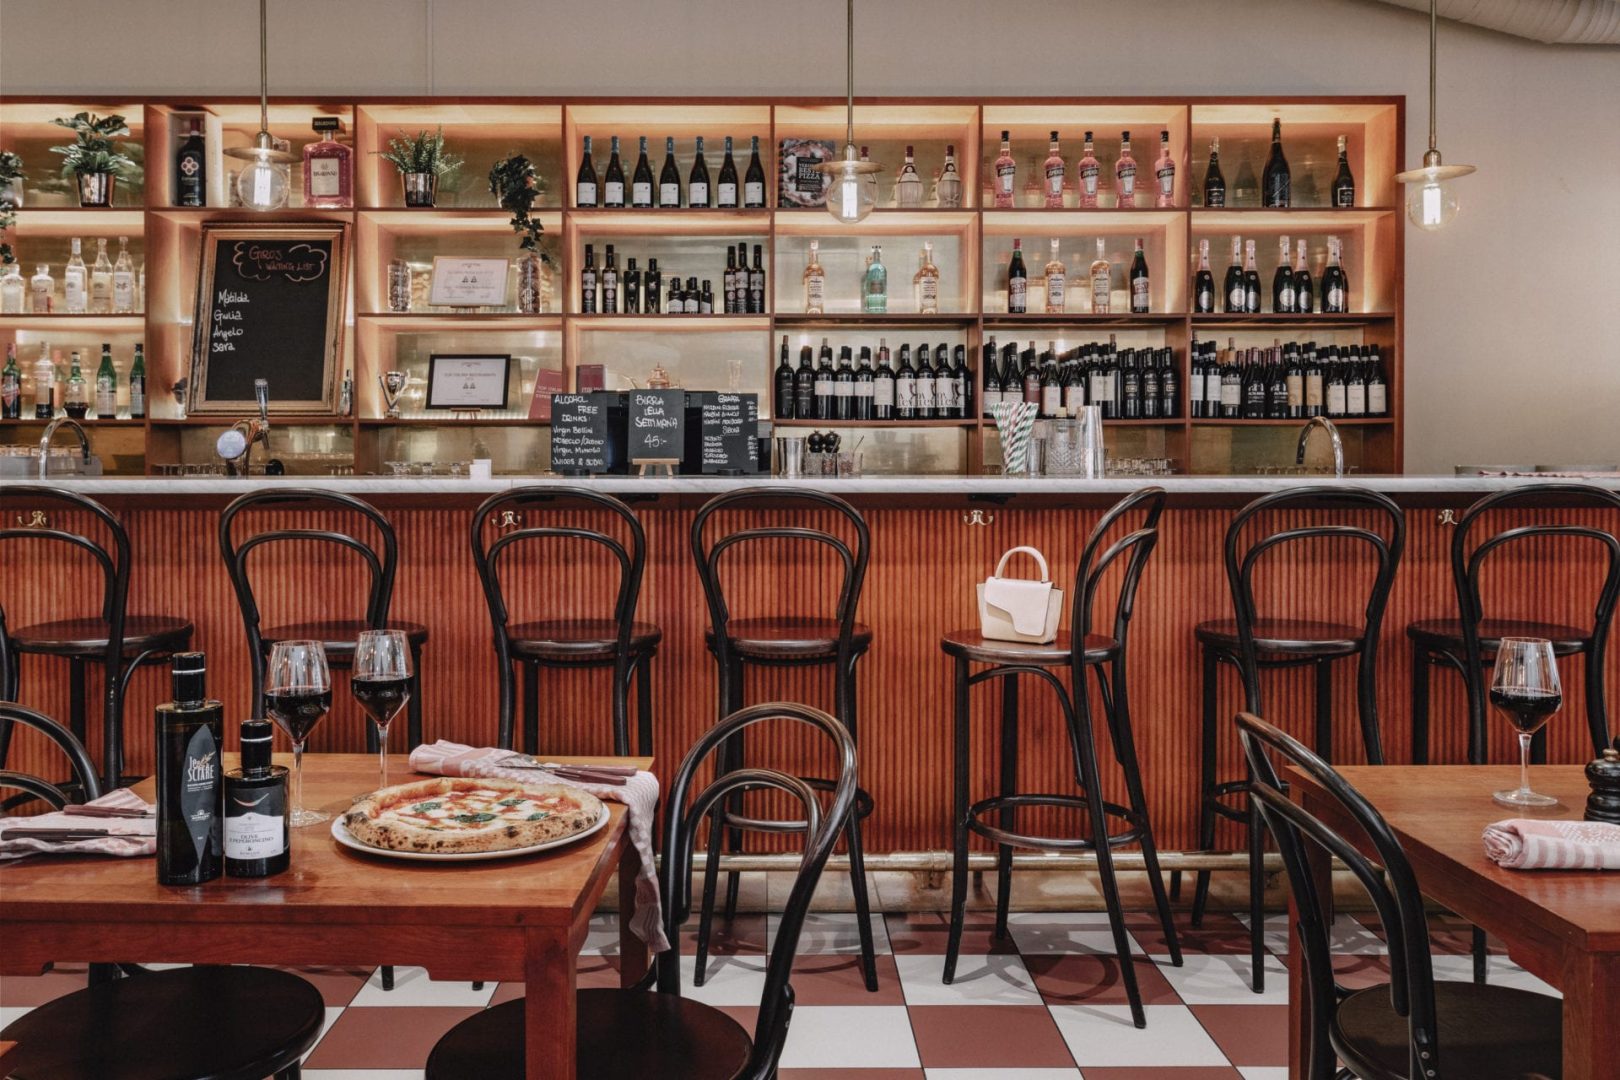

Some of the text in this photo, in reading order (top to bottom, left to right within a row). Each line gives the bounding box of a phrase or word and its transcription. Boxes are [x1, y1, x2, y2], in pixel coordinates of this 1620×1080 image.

[296, 263, 316, 271] LIST
[554, 394, 588, 404] ALCOHOL
[577, 405, 599, 415] FREE
